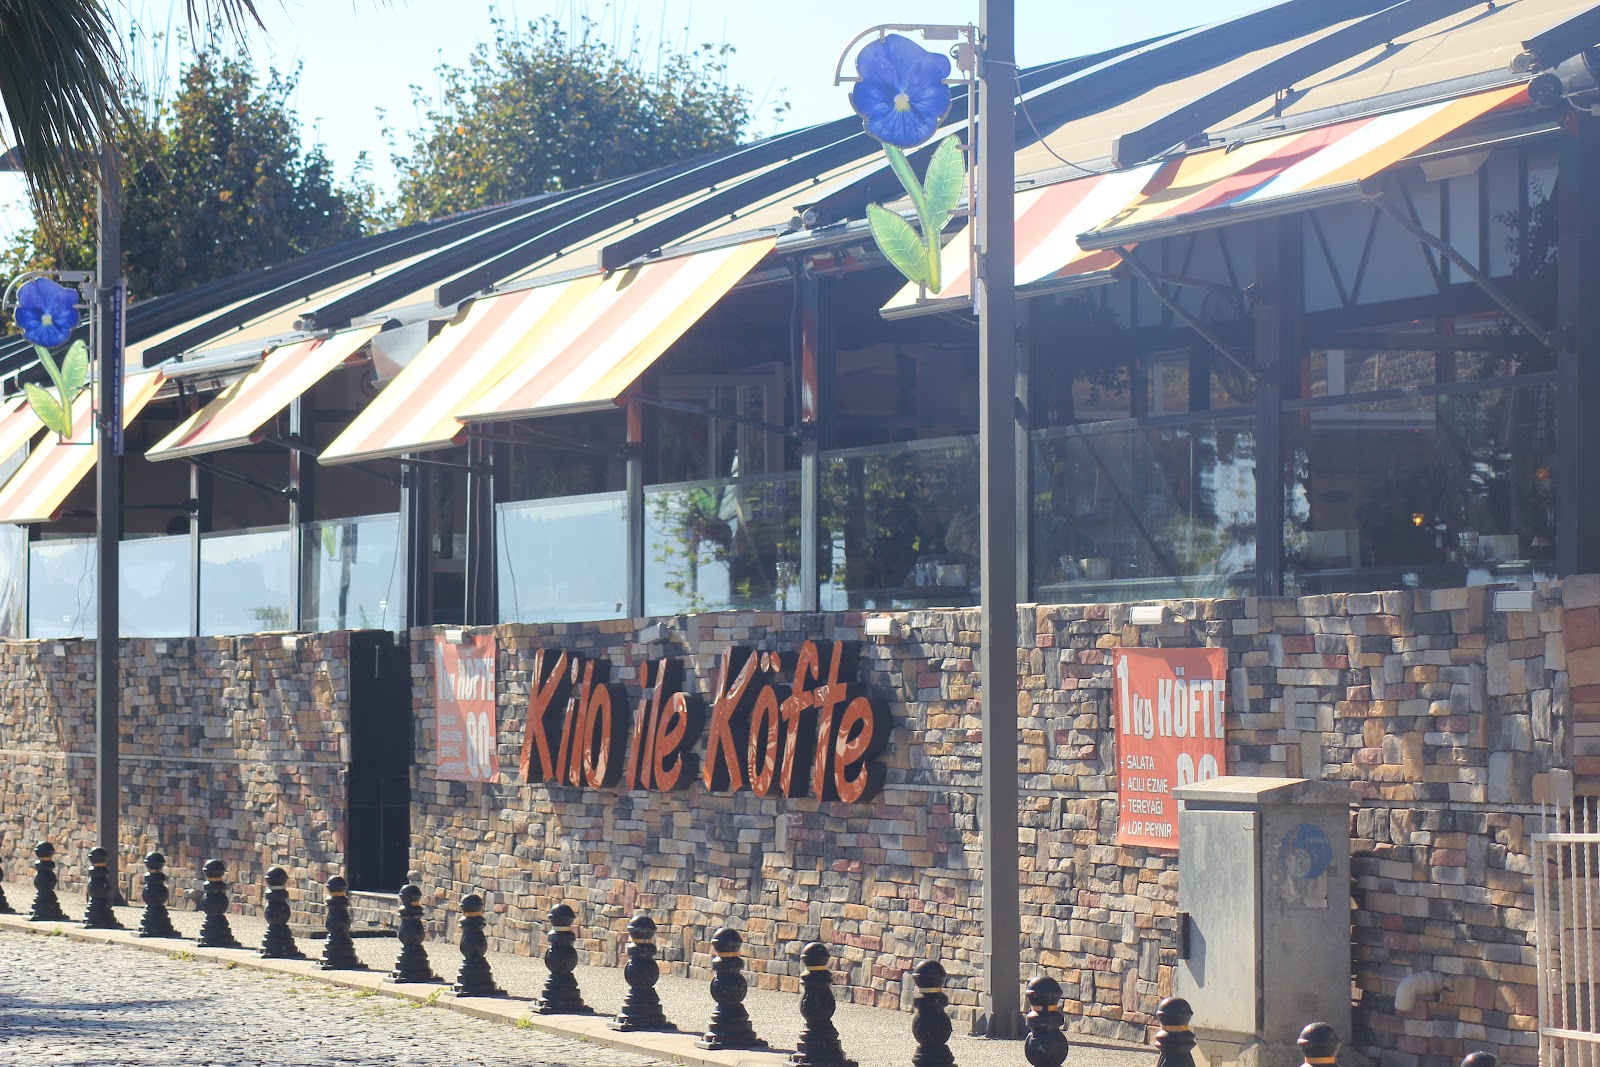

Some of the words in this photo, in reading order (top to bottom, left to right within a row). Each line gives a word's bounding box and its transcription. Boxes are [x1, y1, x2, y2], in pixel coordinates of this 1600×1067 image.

[1117, 654, 1131, 735] 1
[1133, 693, 1155, 740] kg
[1157, 666, 1226, 740] KÖFTE
[520, 647, 612, 790] Kilo
[626, 658, 688, 792] ile
[703, 639, 874, 804] Köfte
[466, 711, 492, 779] 80
[1126, 755, 1155, 770] SALATA
[1127, 778, 1145, 793] ACILI
[1146, 778, 1169, 794] EZME
[1128, 797, 1163, 815] TEREYAĞI
[1127, 821, 1143, 836] LOR
[1144, 819, 1172, 838] PEYNİR
